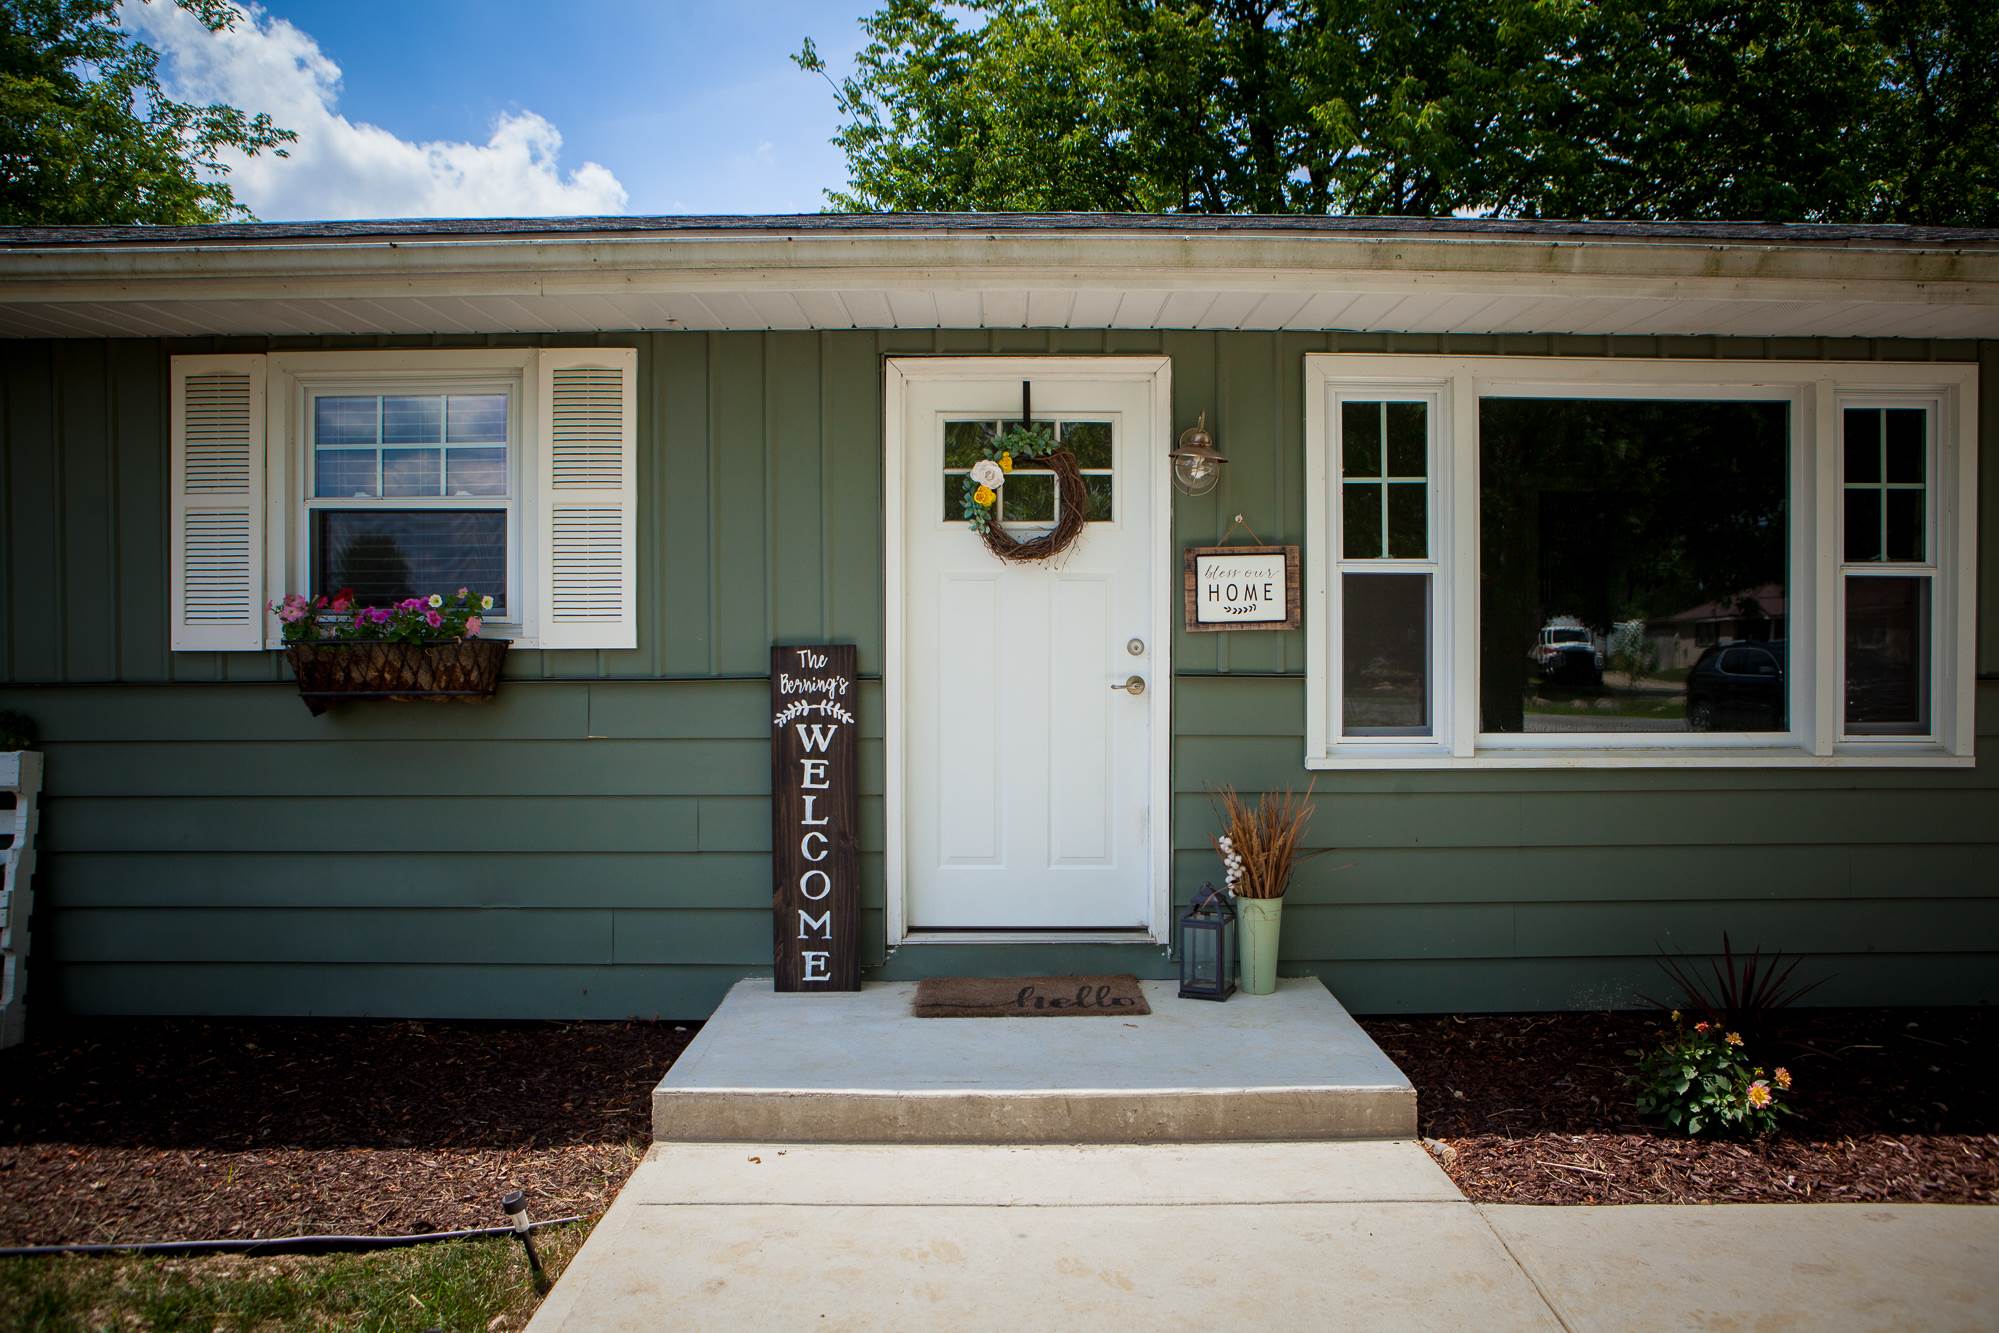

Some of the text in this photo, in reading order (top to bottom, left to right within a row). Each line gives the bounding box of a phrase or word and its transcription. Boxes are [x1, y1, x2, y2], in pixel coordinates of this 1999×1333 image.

[1204, 564, 1279, 579] bless our
[1208, 583, 1273, 602] HOME
[796, 649, 828, 669] The
[780, 673, 849, 699] Berning's
[796, 724, 839, 981] WELCOME
[1015, 985, 1135, 1009] hello
